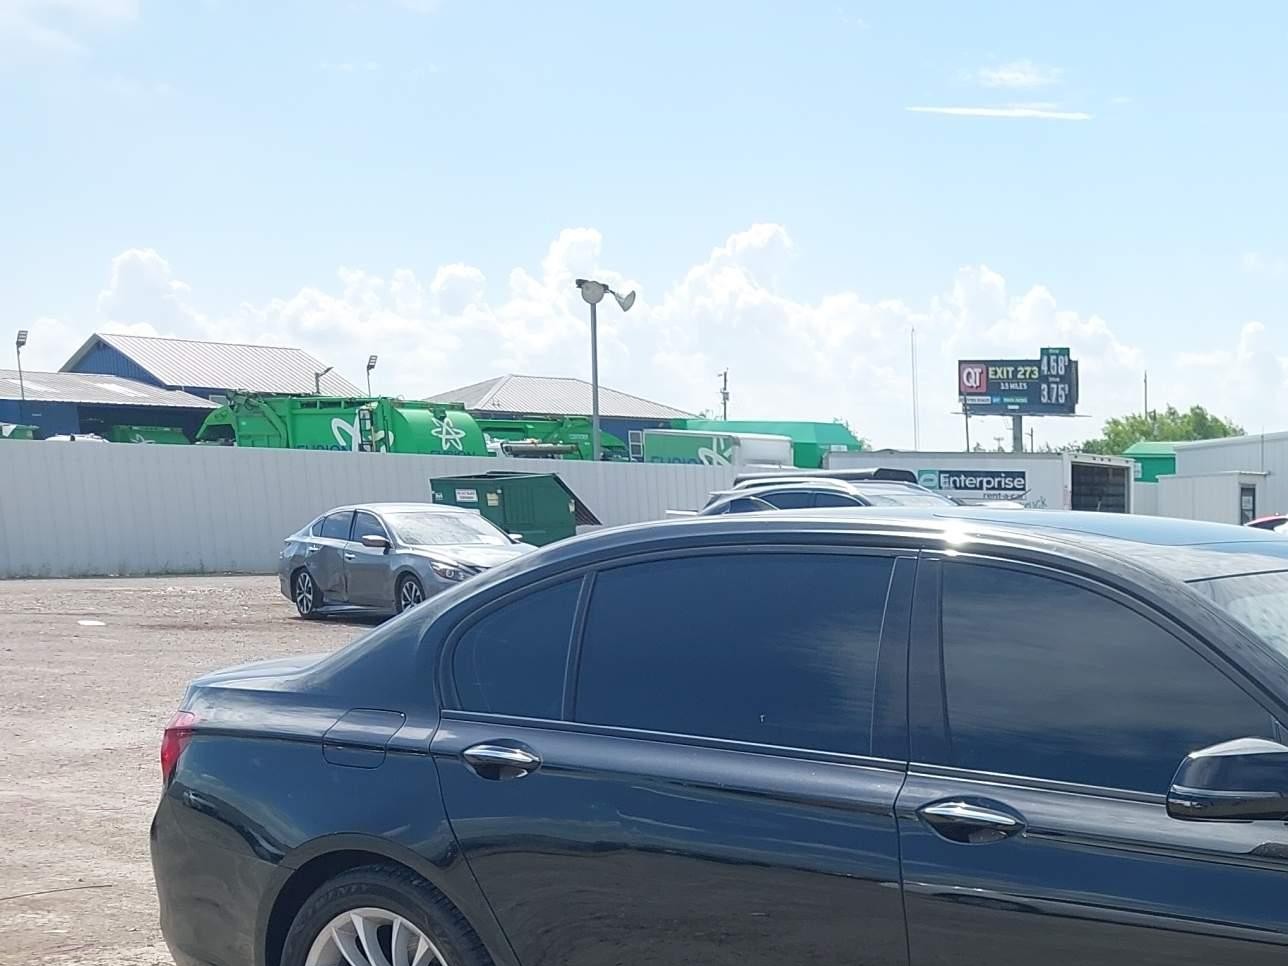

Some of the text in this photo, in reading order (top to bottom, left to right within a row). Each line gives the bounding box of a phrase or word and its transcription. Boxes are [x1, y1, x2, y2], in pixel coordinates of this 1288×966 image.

[963, 367, 982, 387] QT
[988, 366, 1039, 379] EXIT 273
[940, 473, 1024, 491] Enterprise
